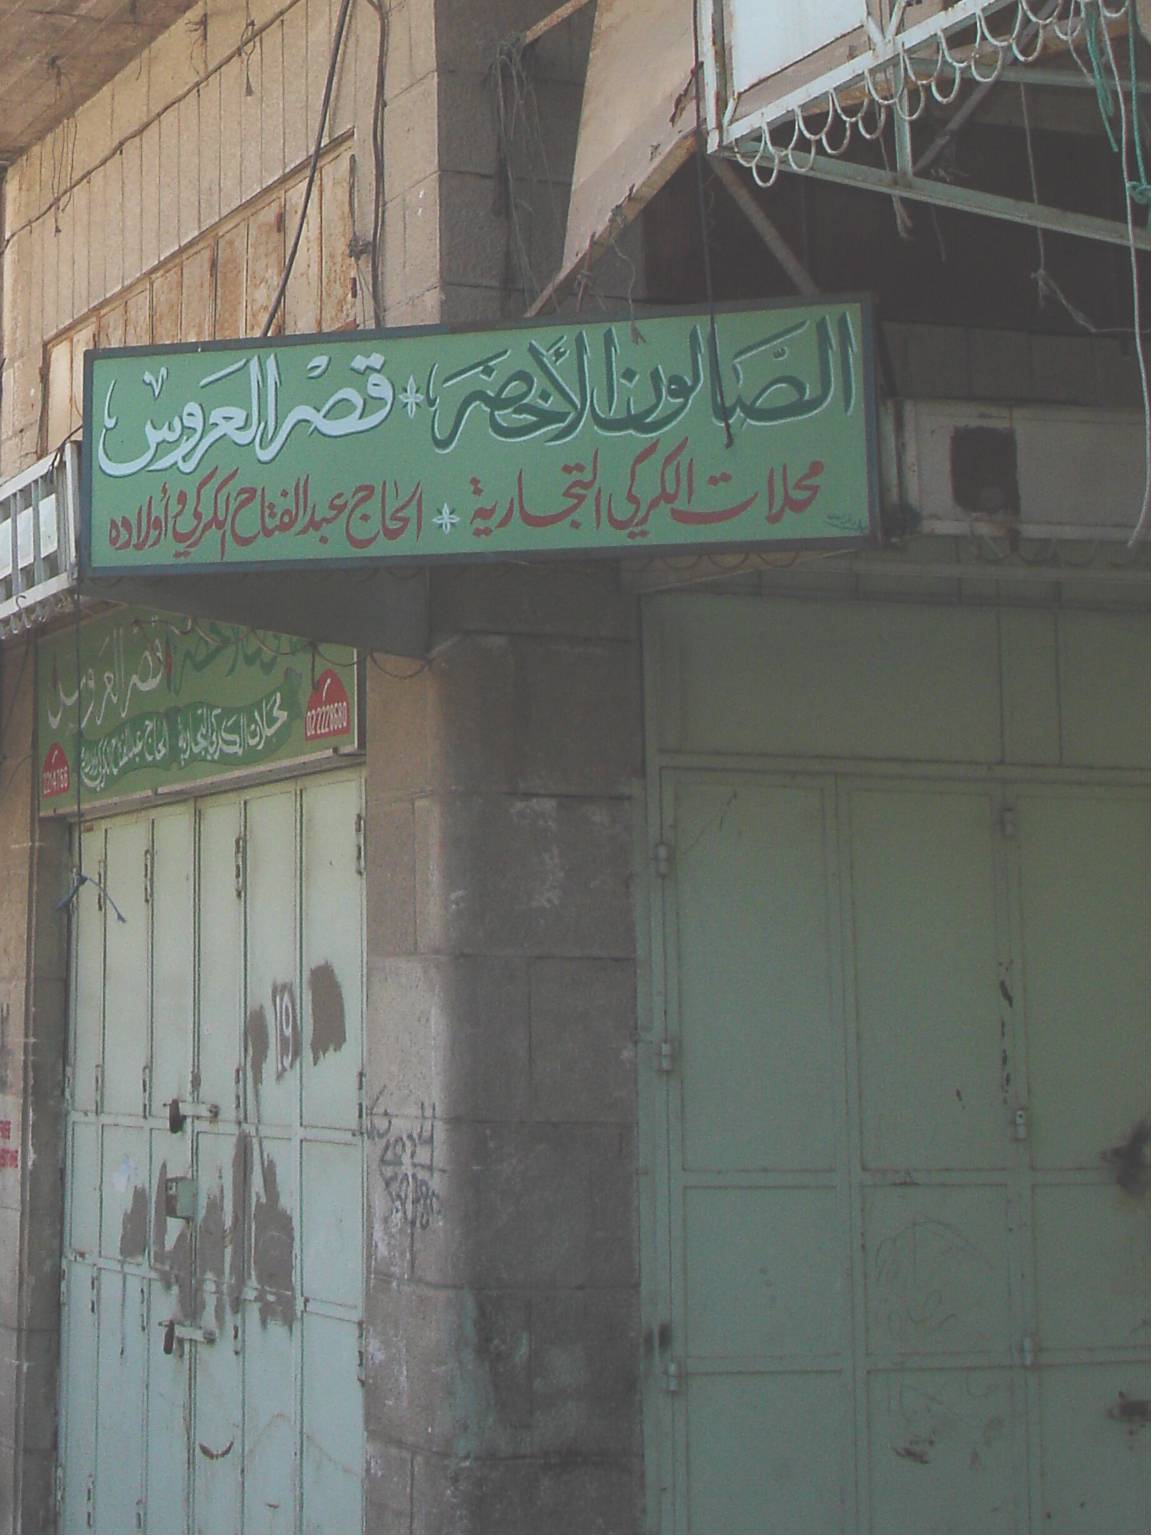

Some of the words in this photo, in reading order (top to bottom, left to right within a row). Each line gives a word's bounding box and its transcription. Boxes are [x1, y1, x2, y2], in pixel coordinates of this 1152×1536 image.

[97, 352, 282, 478] العروس
[254, 352, 395, 463] قصر
[426, 325, 619, 453] الأخضر
[344, 479, 424, 549] الحاج
[469, 447, 602, 538] التجارية
[606, 435, 695, 541] الكركي
[669, 459, 825, 525] محلات
[275, 991, 293, 1072] 19
